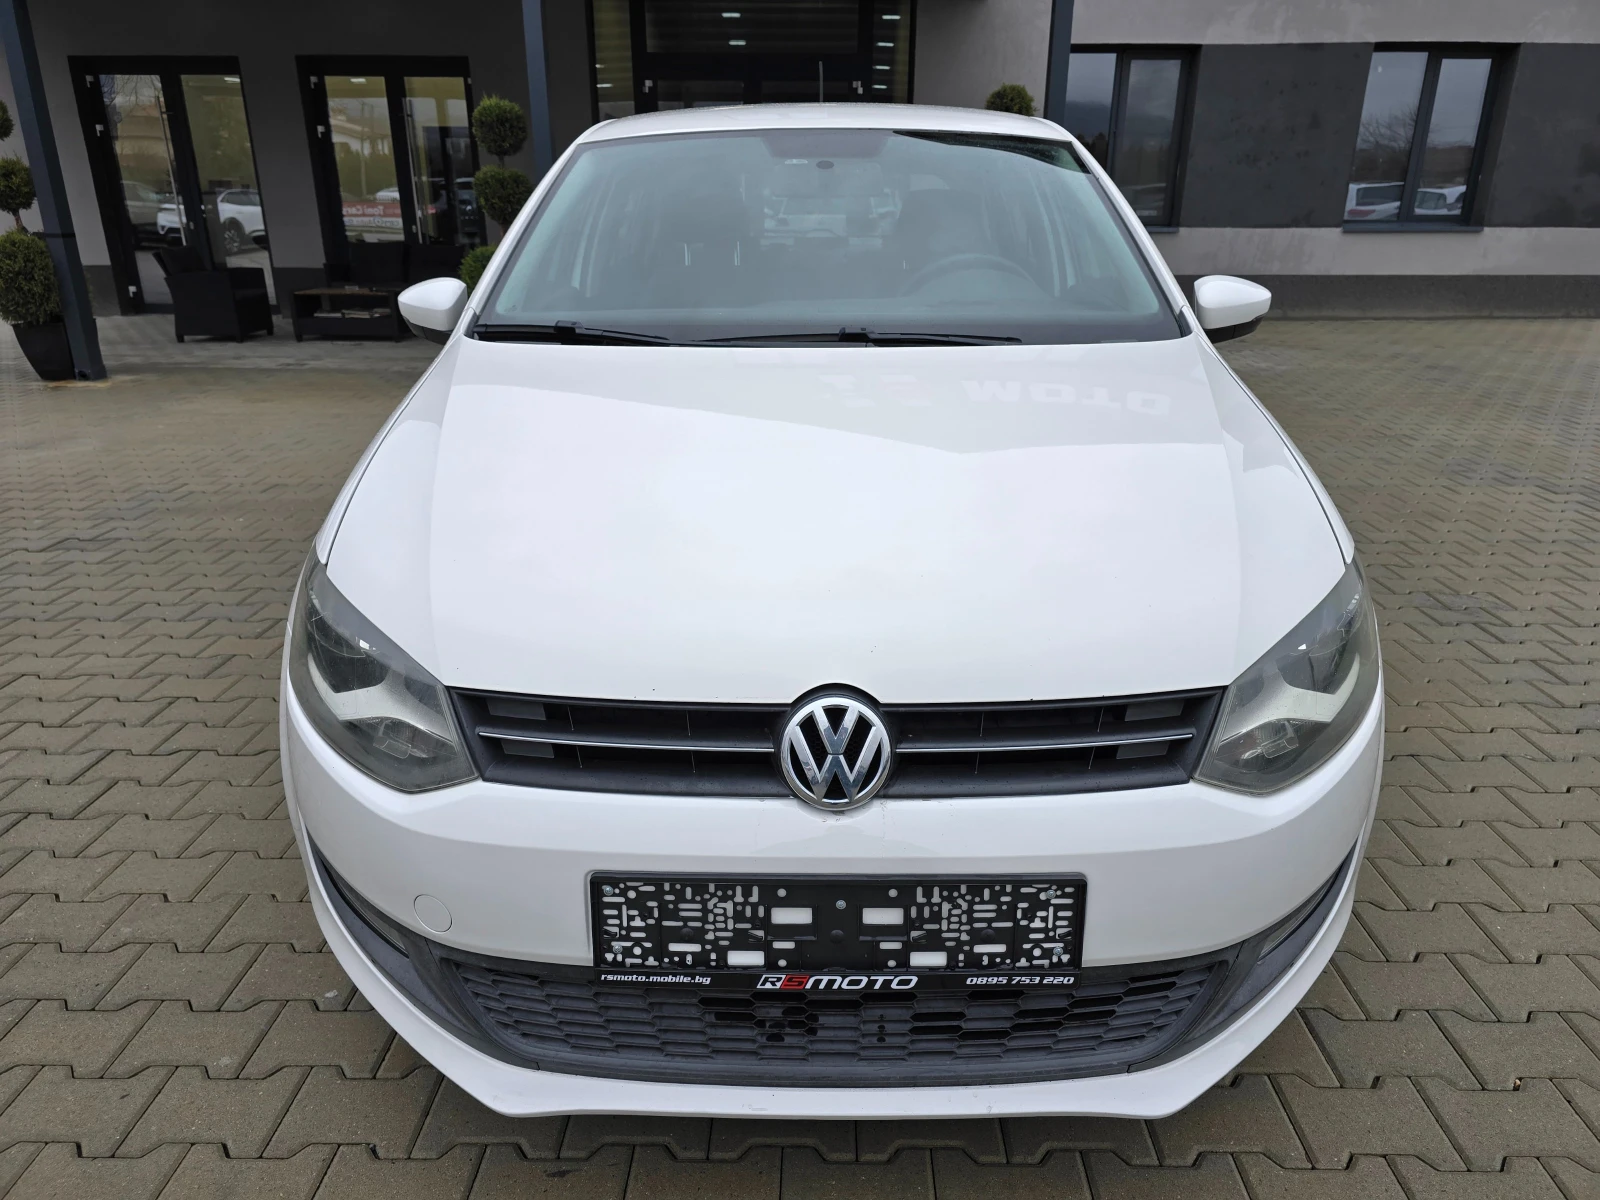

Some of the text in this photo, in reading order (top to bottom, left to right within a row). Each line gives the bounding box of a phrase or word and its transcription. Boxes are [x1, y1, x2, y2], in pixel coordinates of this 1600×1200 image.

[784, 700, 888, 807] VW
[600, 973, 712, 985] rsmoto.mobile.bg
[756, 974, 918, 990] RSMOTO
[966, 976, 1075, 985] 0895 753 220
